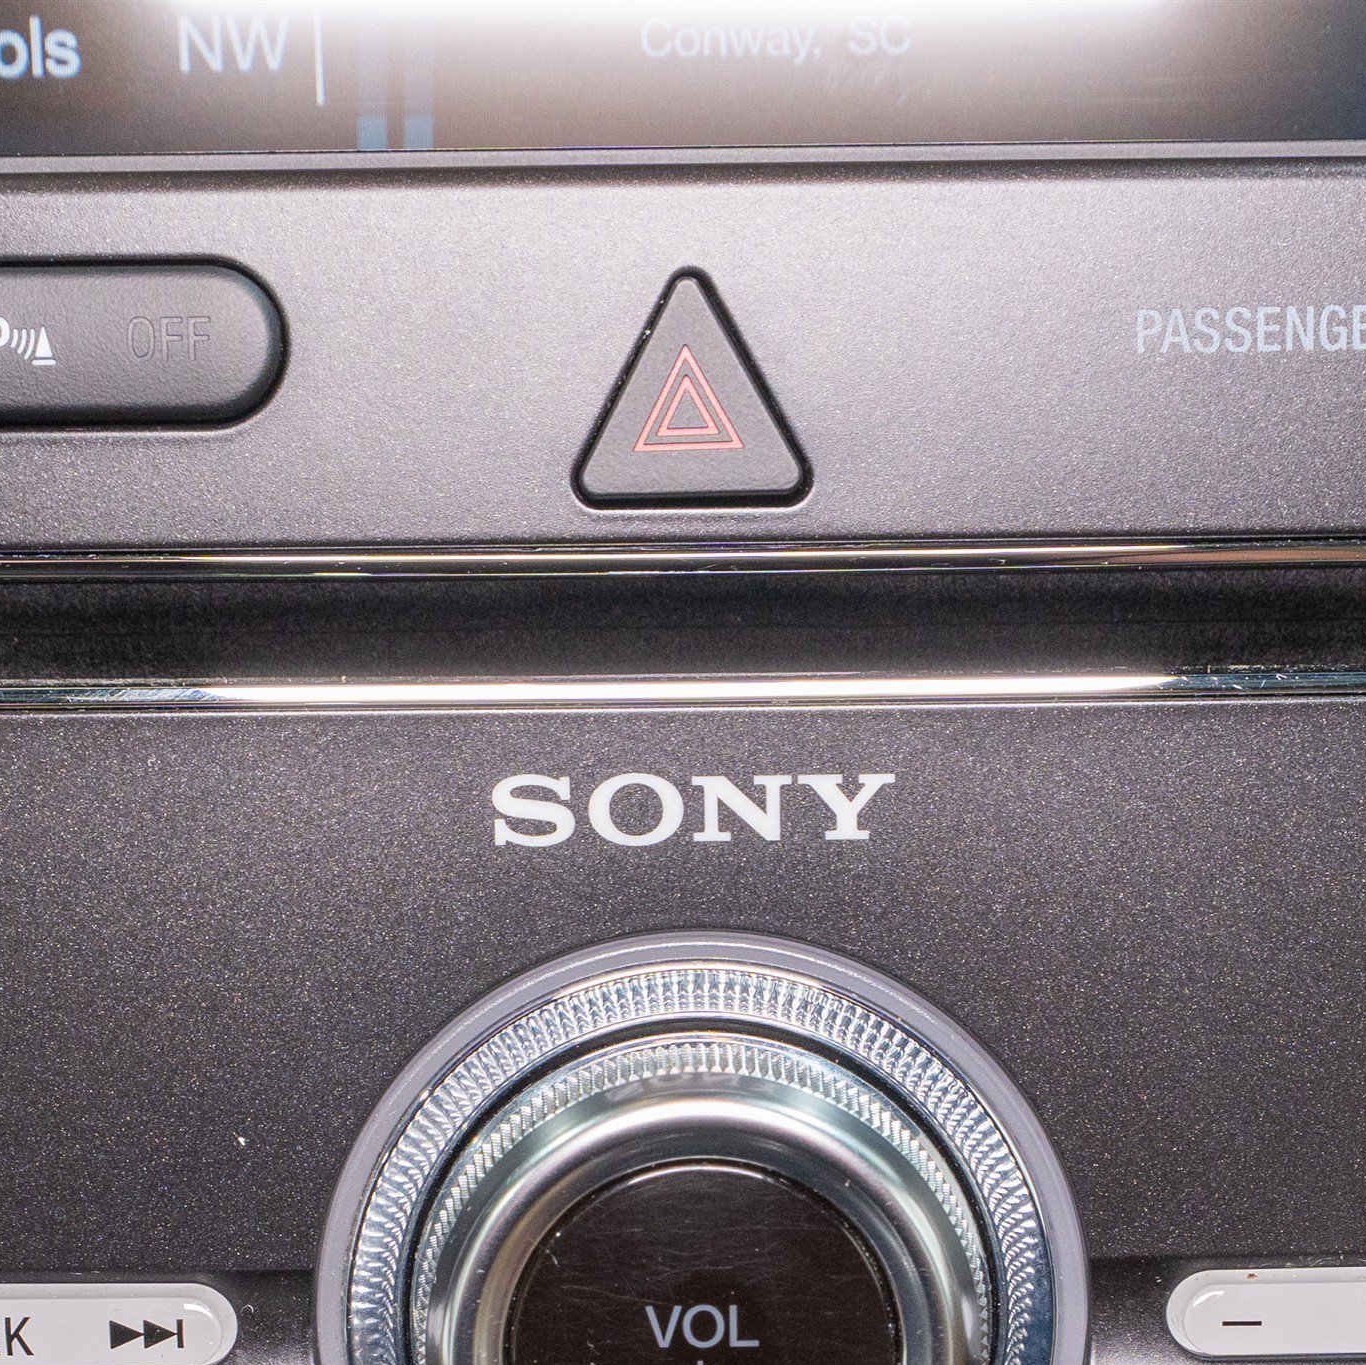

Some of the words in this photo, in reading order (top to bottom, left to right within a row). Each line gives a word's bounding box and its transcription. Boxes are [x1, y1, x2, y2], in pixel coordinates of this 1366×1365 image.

[177, 15, 289, 73] NW
[640, 17, 821, 65] Conway,
[847, 16, 912, 55] SC
[127, 315, 211, 361] OFF
[491, 773, 896, 847] SONY
[645, 1304, 759, 1348] VOL
